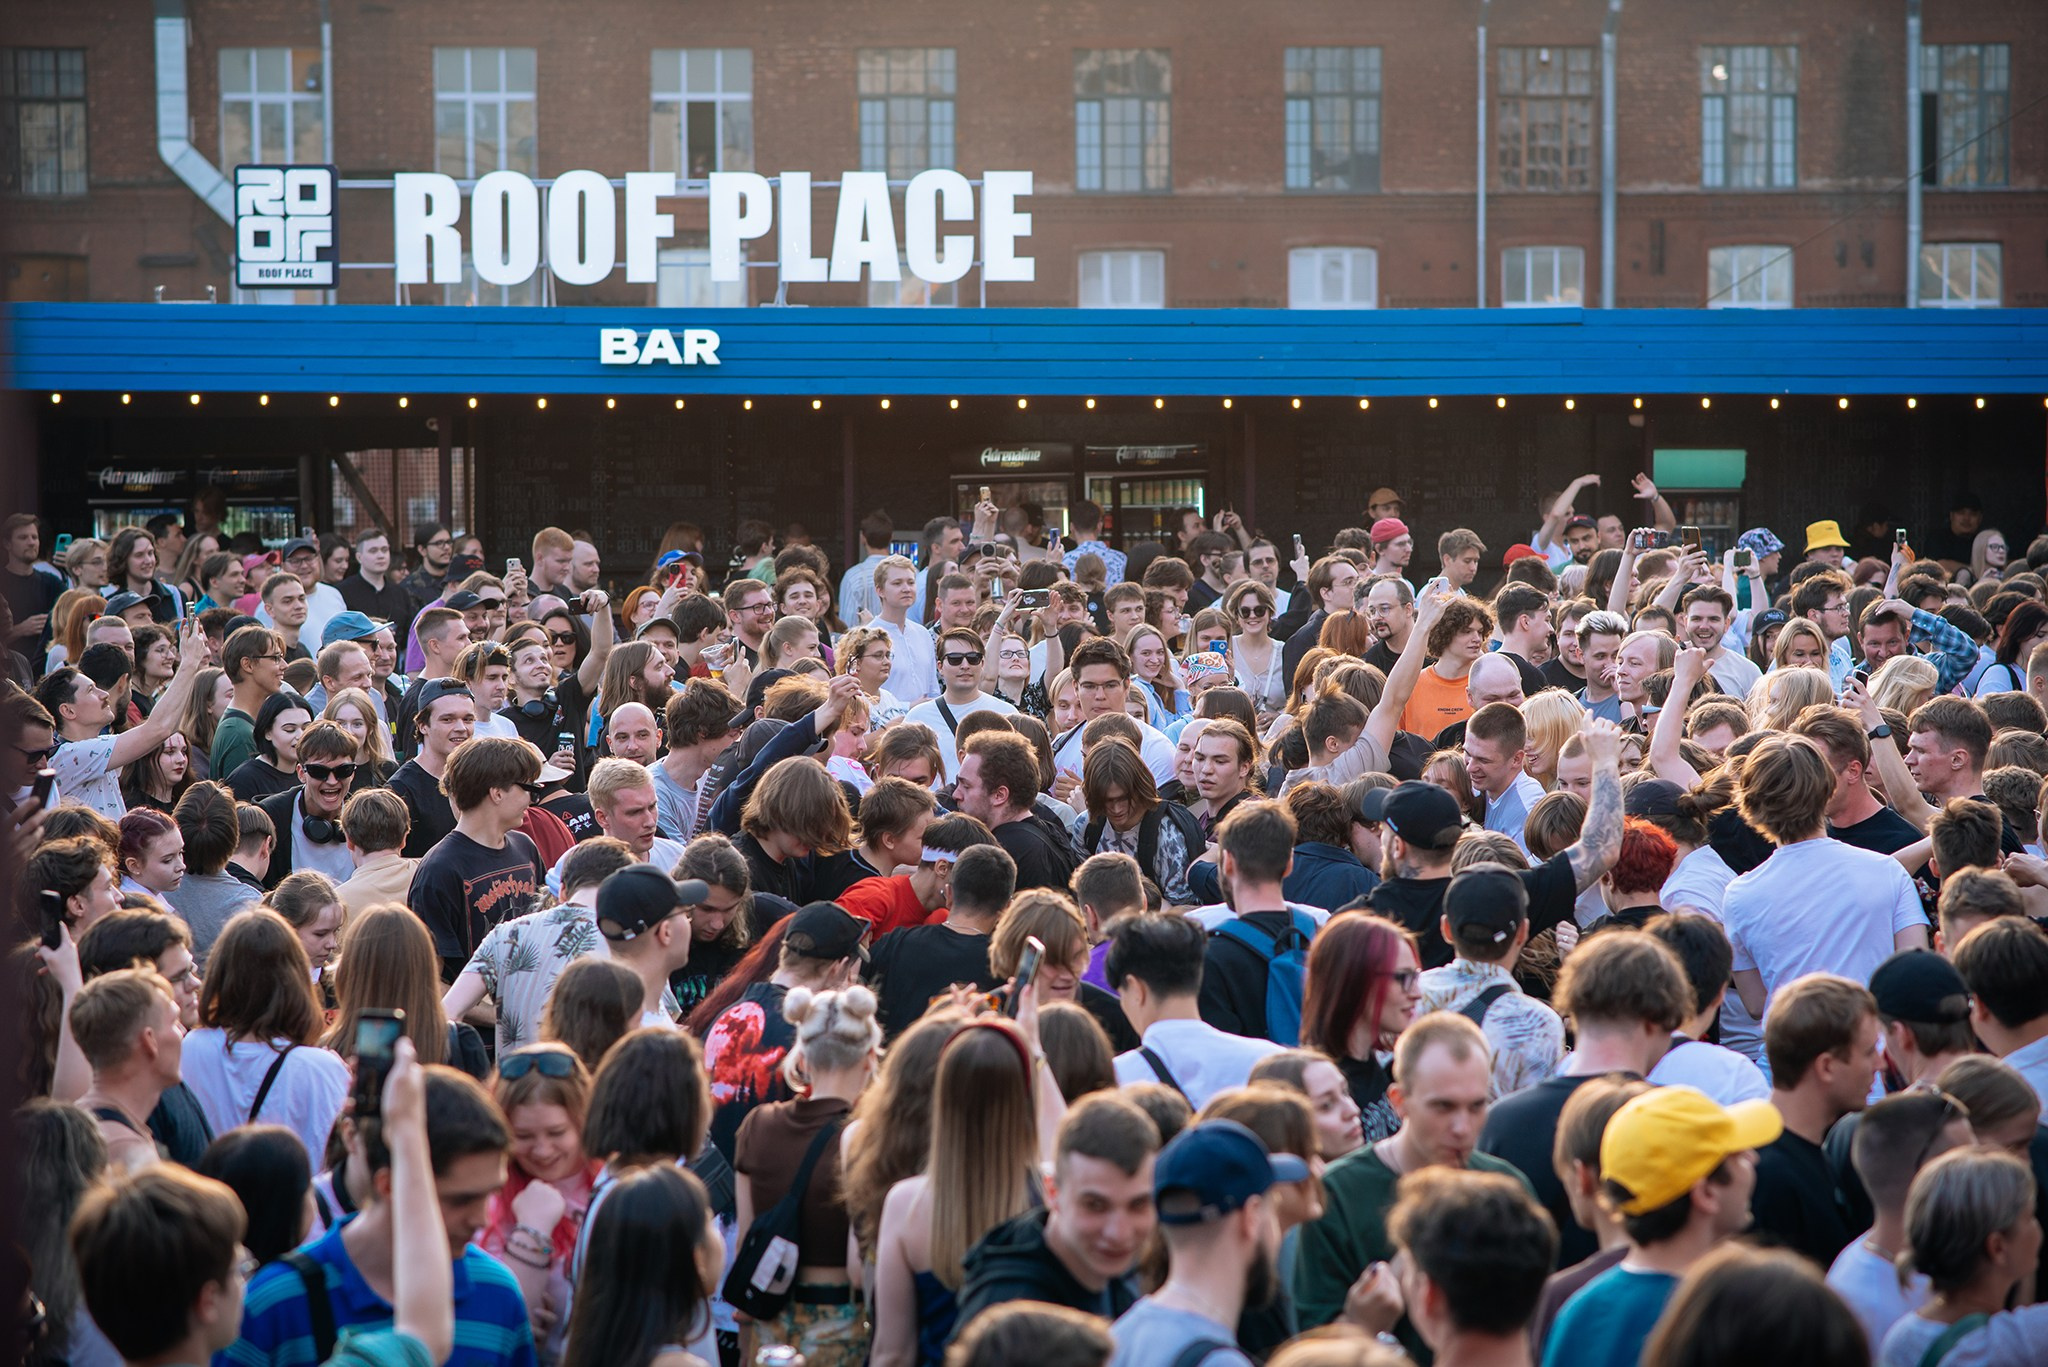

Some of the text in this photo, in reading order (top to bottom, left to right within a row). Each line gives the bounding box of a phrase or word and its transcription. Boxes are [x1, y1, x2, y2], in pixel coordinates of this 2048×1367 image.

[394, 168, 1035, 286] ROOF PLACE
[258, 268, 313, 278] ROOF PLACE
[600, 328, 722, 365] BAR
[981, 446, 1041, 467] Adrenaline
[99, 466, 176, 491] Adrenaline
